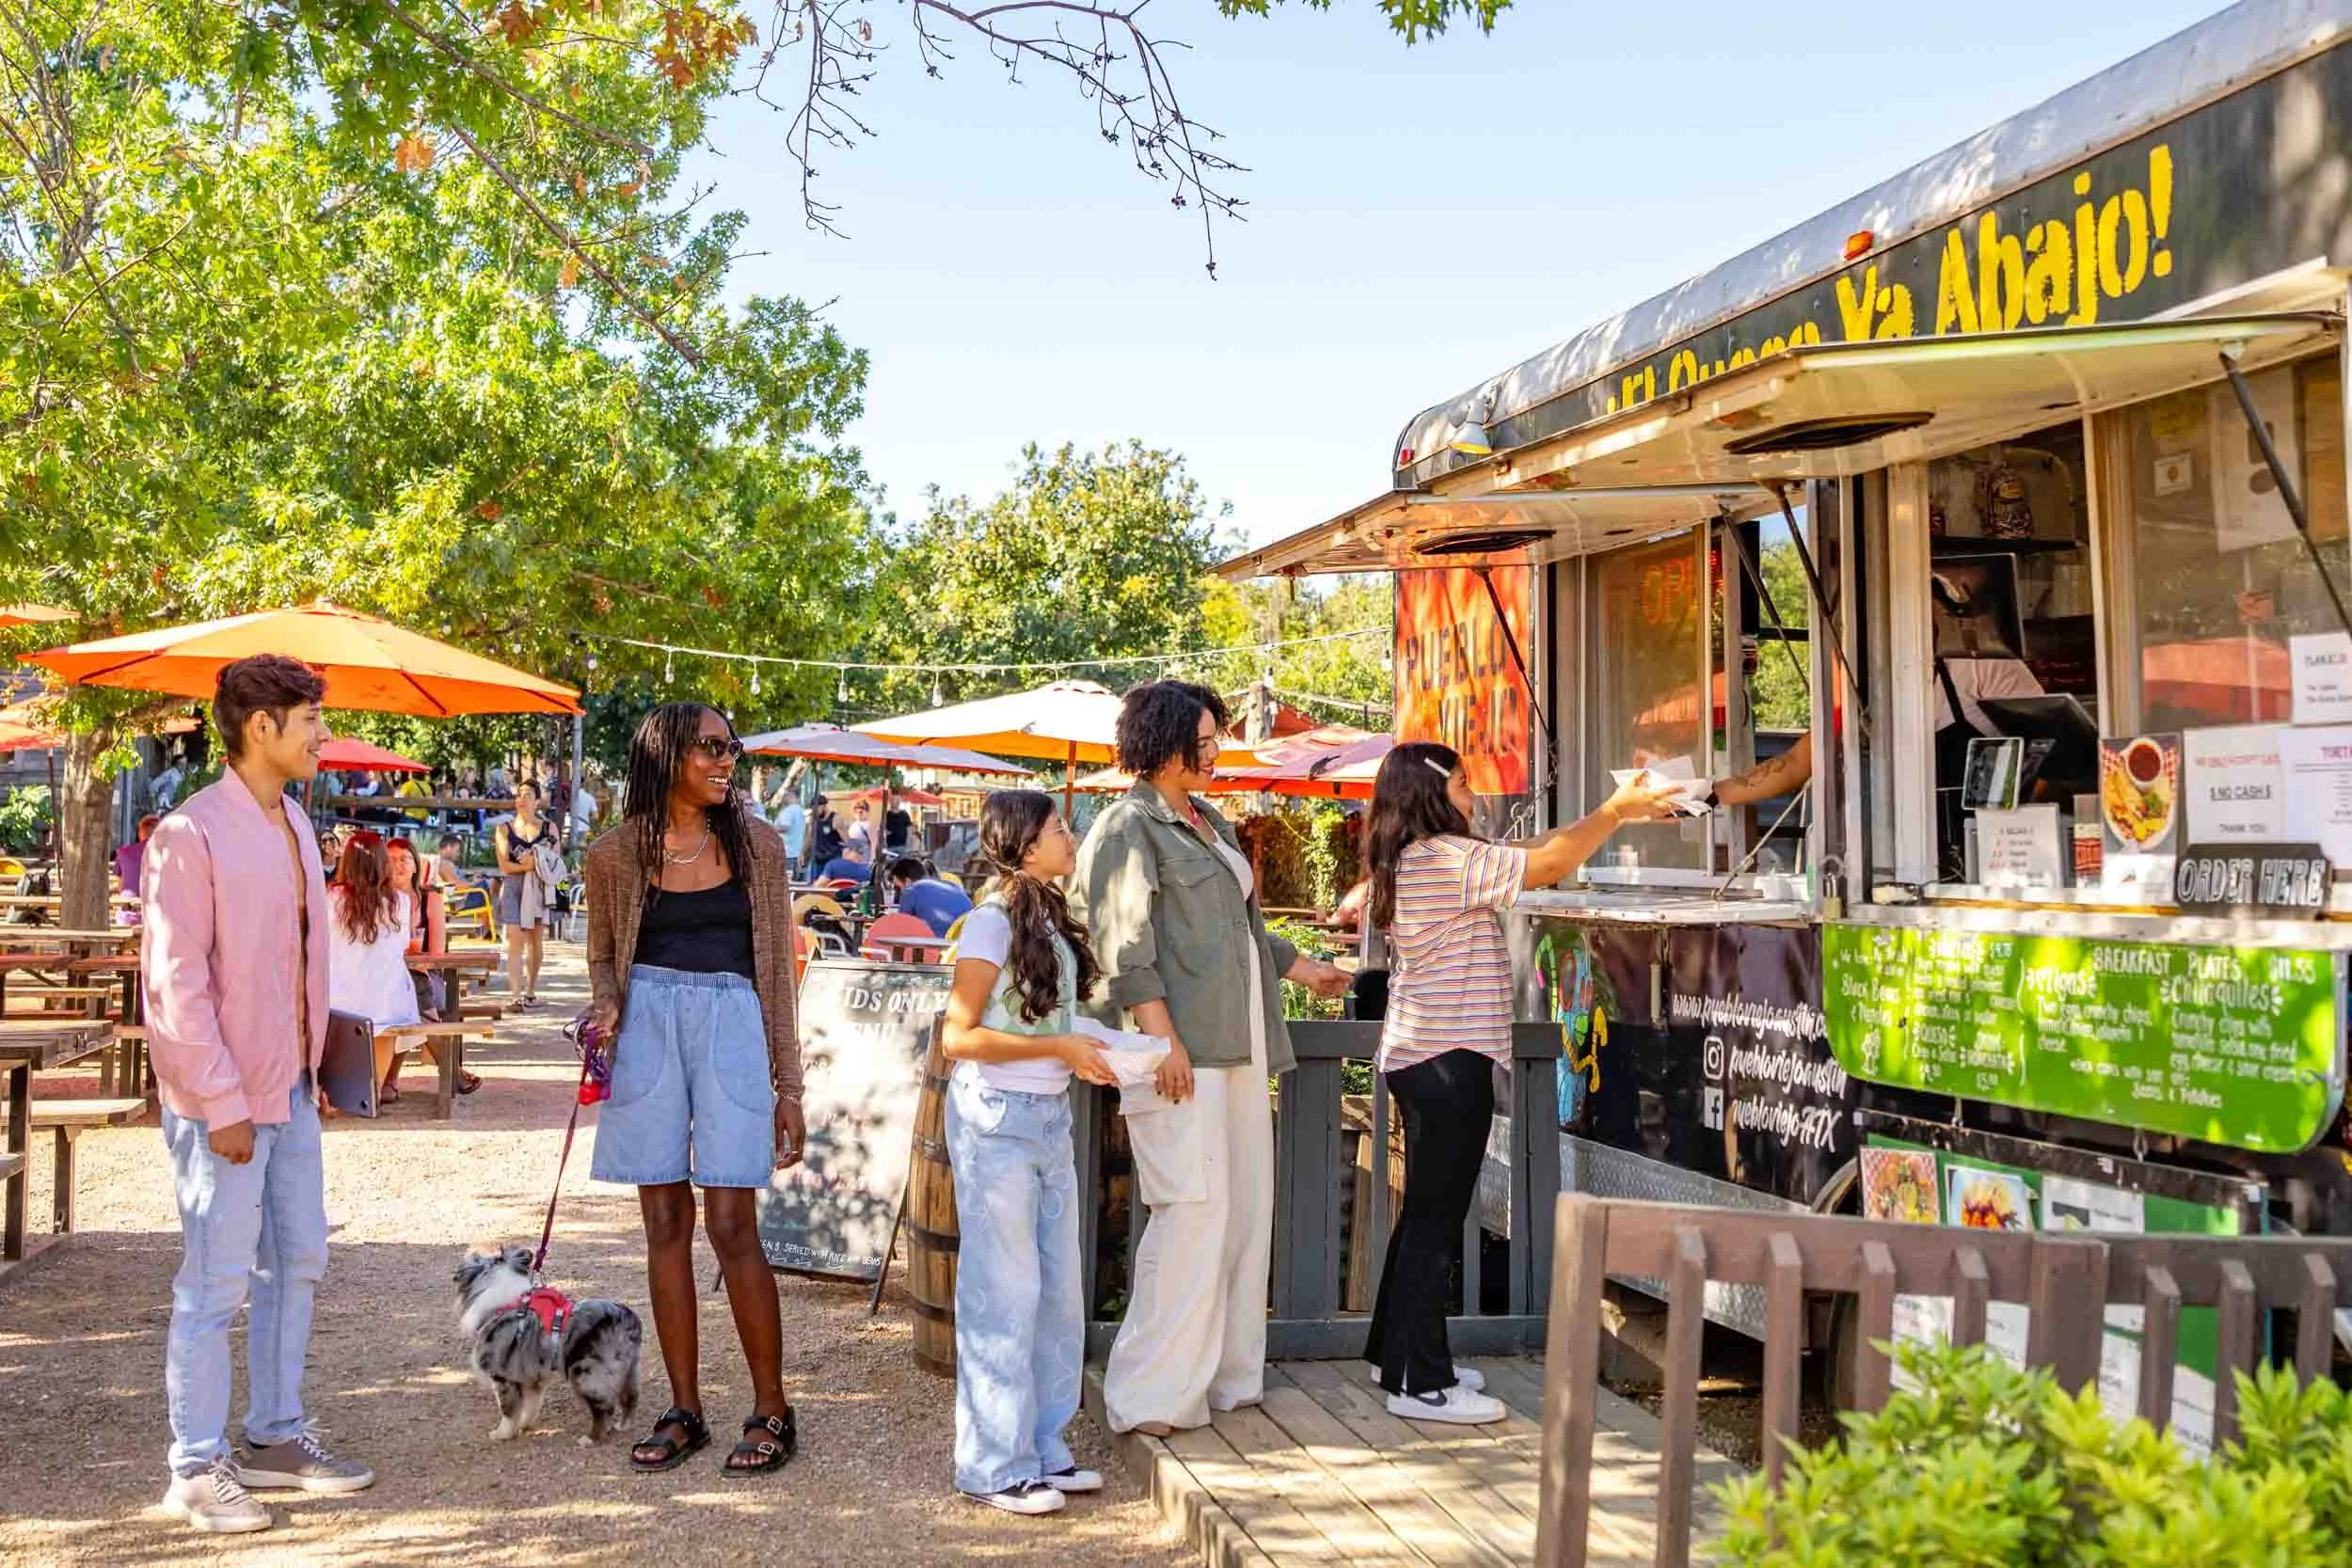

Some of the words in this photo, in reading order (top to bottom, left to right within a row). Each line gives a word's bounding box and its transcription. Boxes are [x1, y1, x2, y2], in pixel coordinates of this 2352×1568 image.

[1935, 144, 2173, 336] Abajo!
[2219, 784, 2233, 800] NO
[2178, 858, 2254, 904] ORDER
[2258, 858, 2327, 907] HERE
[2092, 946, 2172, 975] BREAKFAST
[2188, 951, 2242, 981] PLATES
[887, 990, 951, 1015] ONLY
[1728, 1042, 1848, 1100] puebloviejoaustin
[760, 1239, 781, 1252] EALS
[784, 1243, 811, 1257] SERVED
